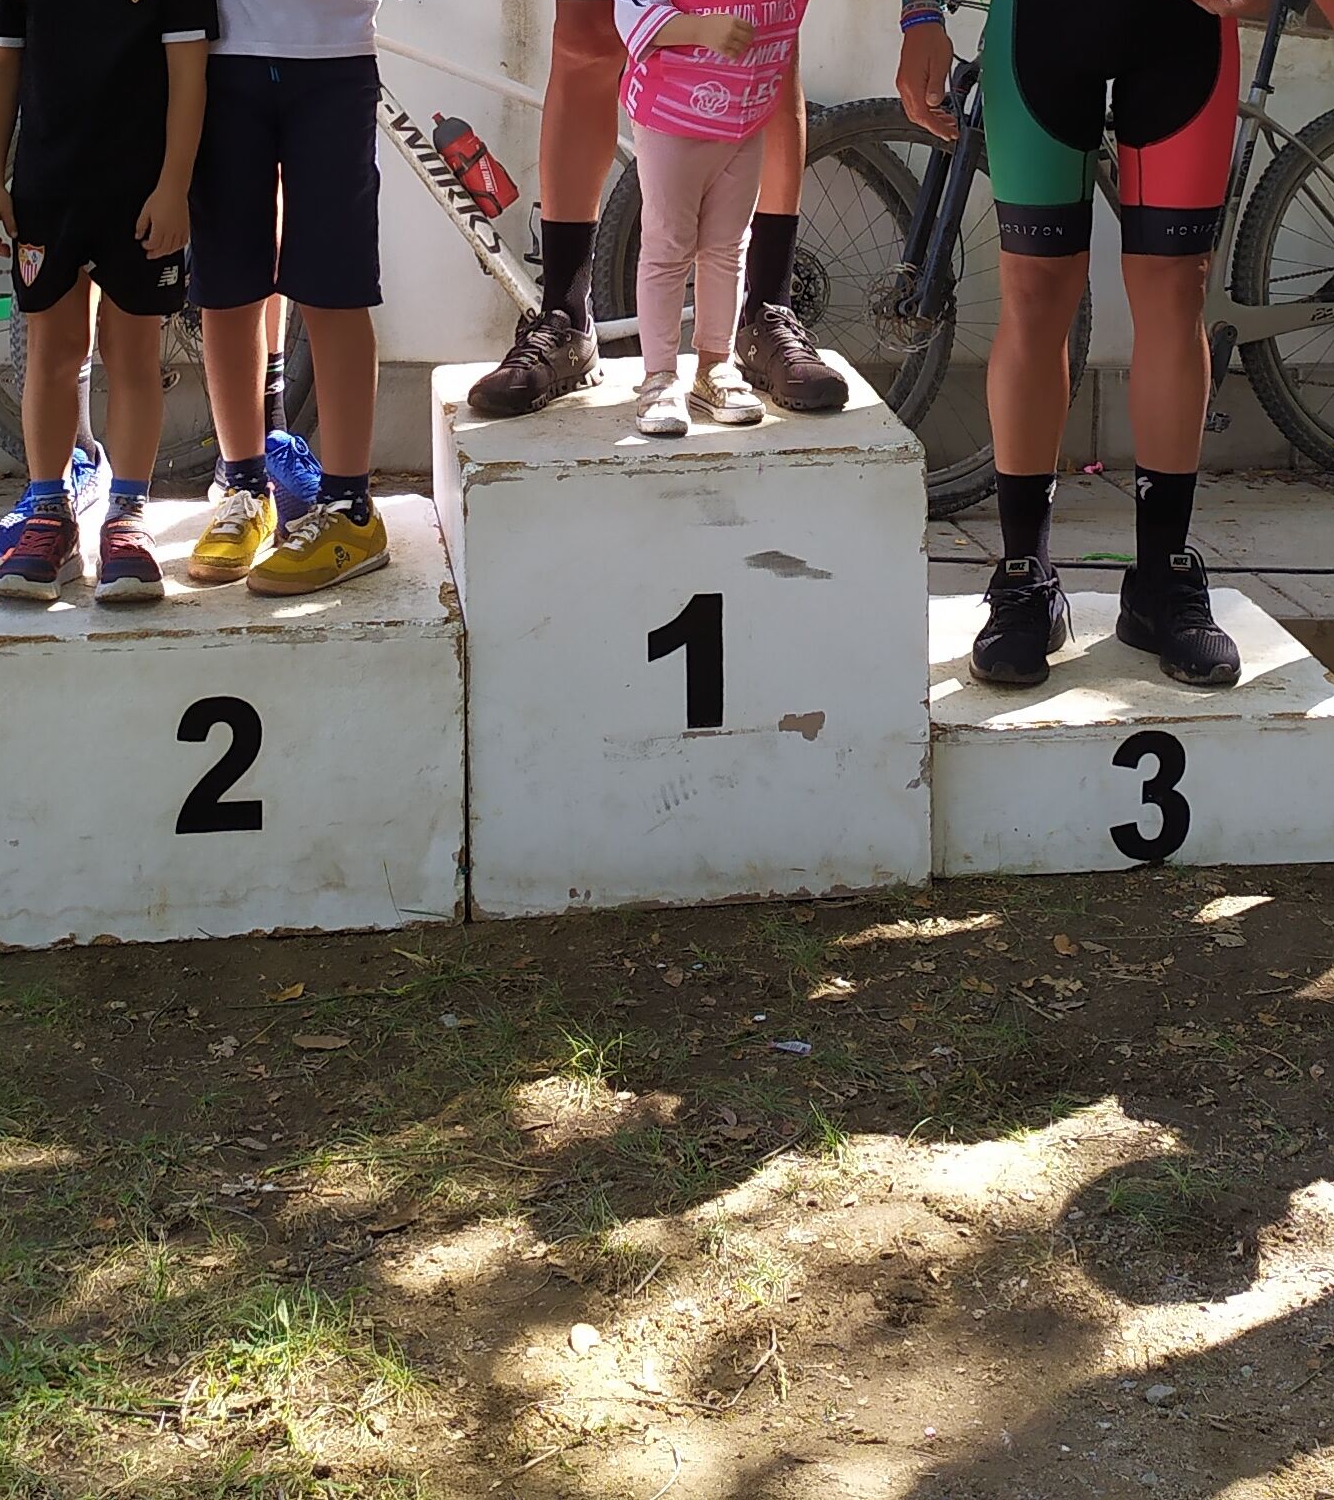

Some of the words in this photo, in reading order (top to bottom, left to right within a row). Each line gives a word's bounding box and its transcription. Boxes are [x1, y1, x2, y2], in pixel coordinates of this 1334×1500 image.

[648, 593, 723, 729] 1
[176, 697, 262, 834] 2
[1110, 731, 1190, 862] 3
